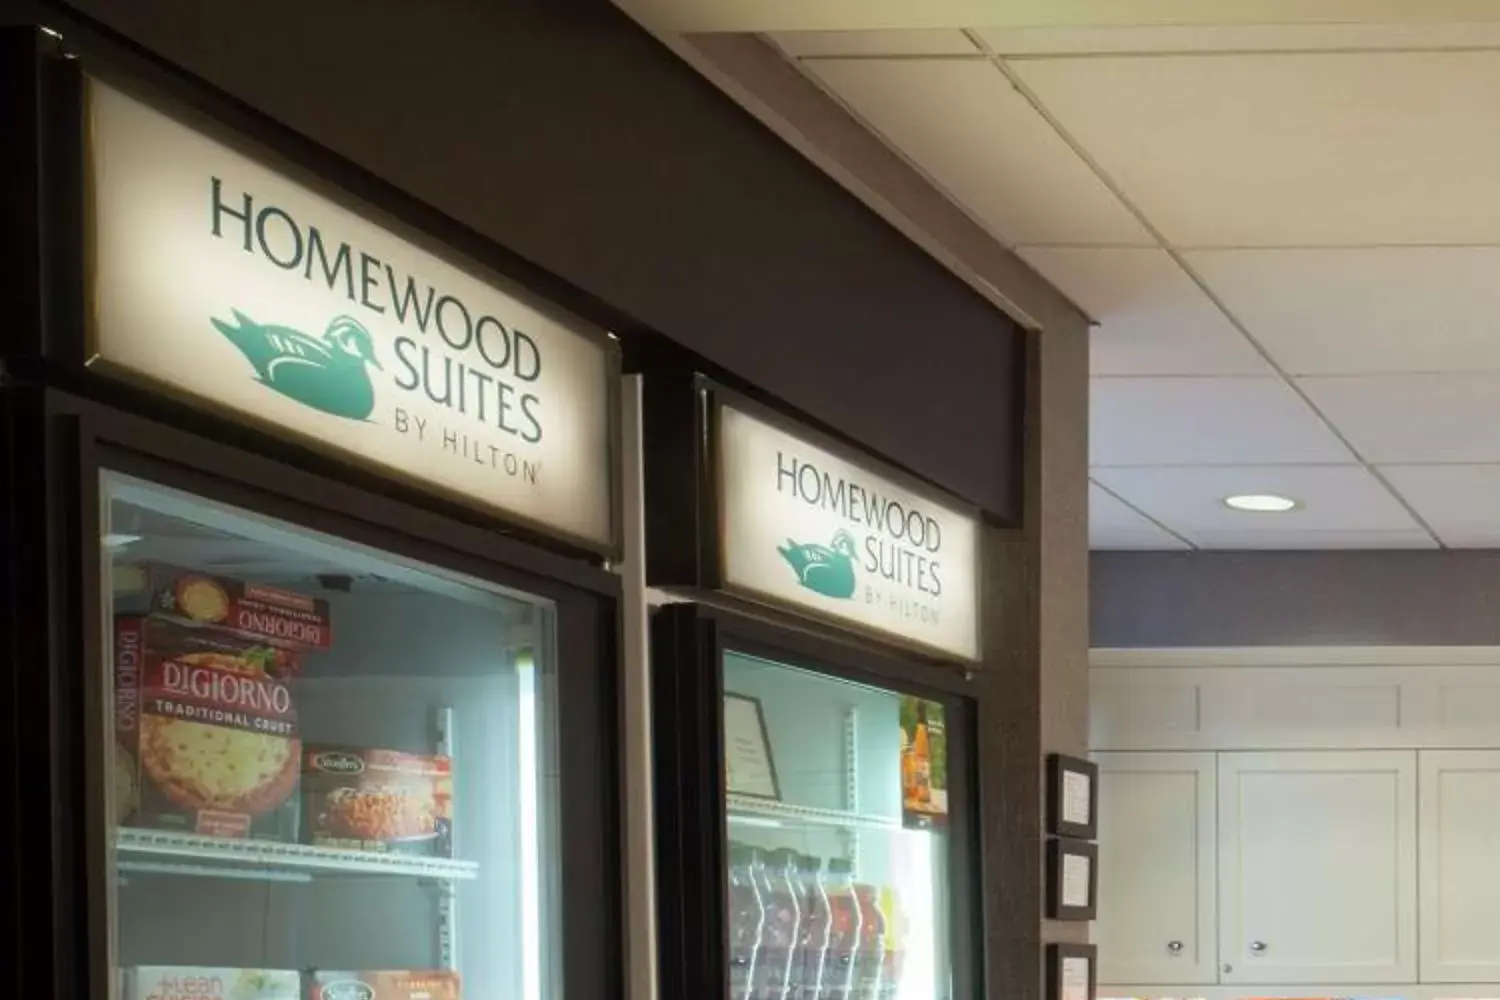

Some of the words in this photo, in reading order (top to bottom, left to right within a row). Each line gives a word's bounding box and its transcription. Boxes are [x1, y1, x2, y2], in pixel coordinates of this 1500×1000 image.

[210, 176, 541, 383] HOMEWOOD
[393, 336, 543, 444] SUITES
[394, 407, 428, 441] BY
[443, 427, 536, 485] HILTON
[777, 451, 941, 553] HOMEWOOD
[865, 536, 942, 597] SUITES
[155, 700, 249, 726] TRADITIONAL
[253, 718, 293, 734] CRUST
